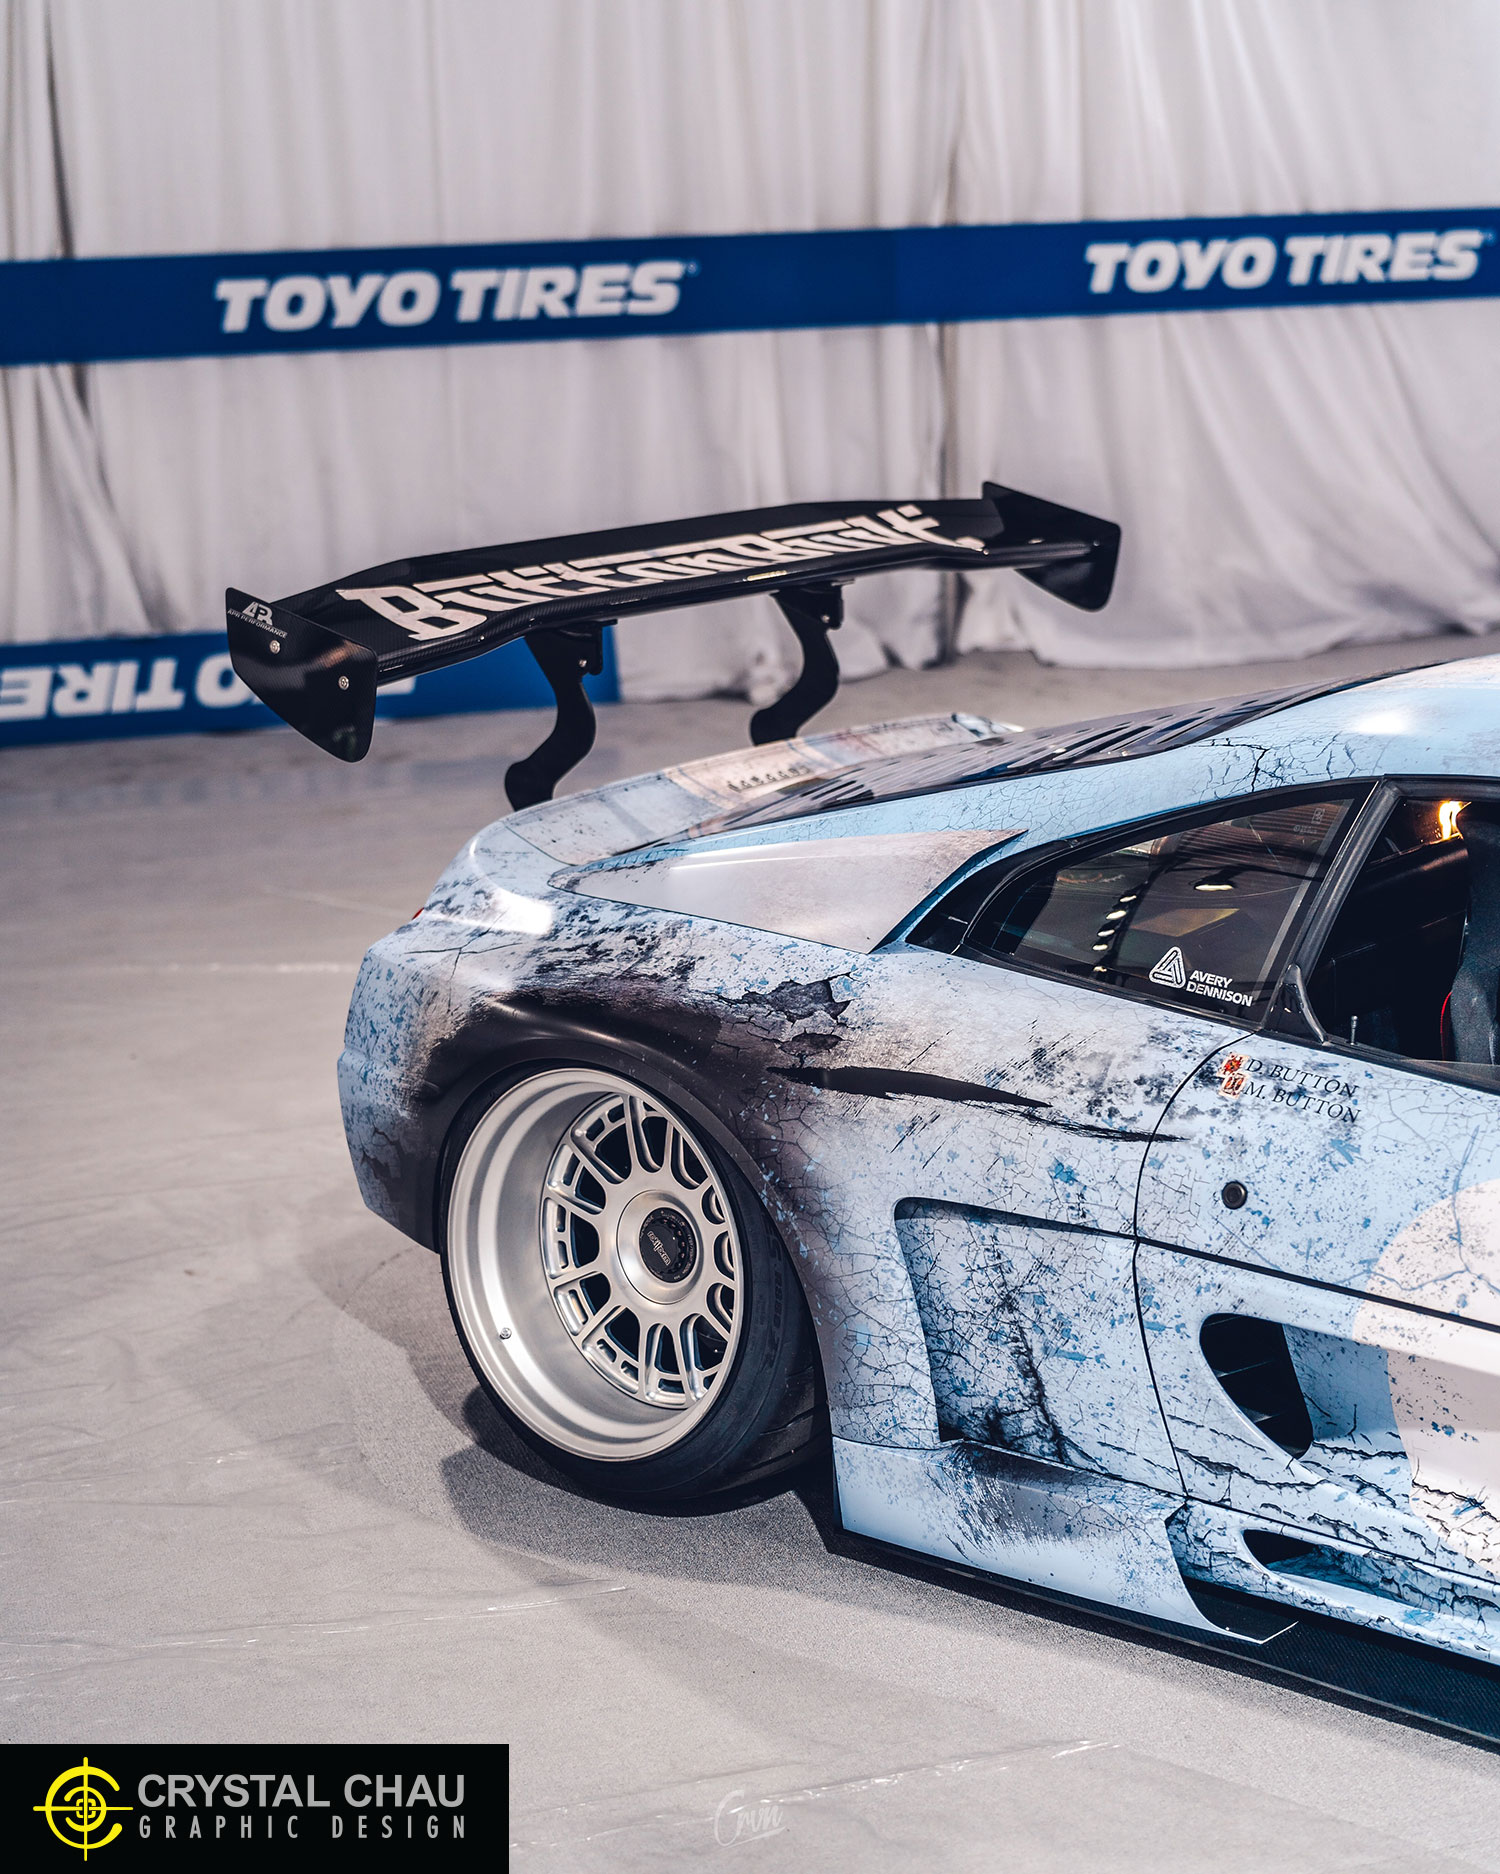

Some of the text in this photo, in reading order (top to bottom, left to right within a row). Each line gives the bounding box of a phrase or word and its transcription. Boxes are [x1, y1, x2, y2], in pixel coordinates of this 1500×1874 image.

[1086, 229, 1483, 294] TOYO TIRES
[215, 261, 685, 332] TOYO TIRES
[240, 612, 288, 639] PERFORMANCE
[1186, 980, 1253, 1007] DENNISON
[1189, 969, 1233, 989] AVERY
[1247, 1058, 1360, 1099] D. BUTTON
[1244, 1081, 1362, 1124] M. BUTTON
